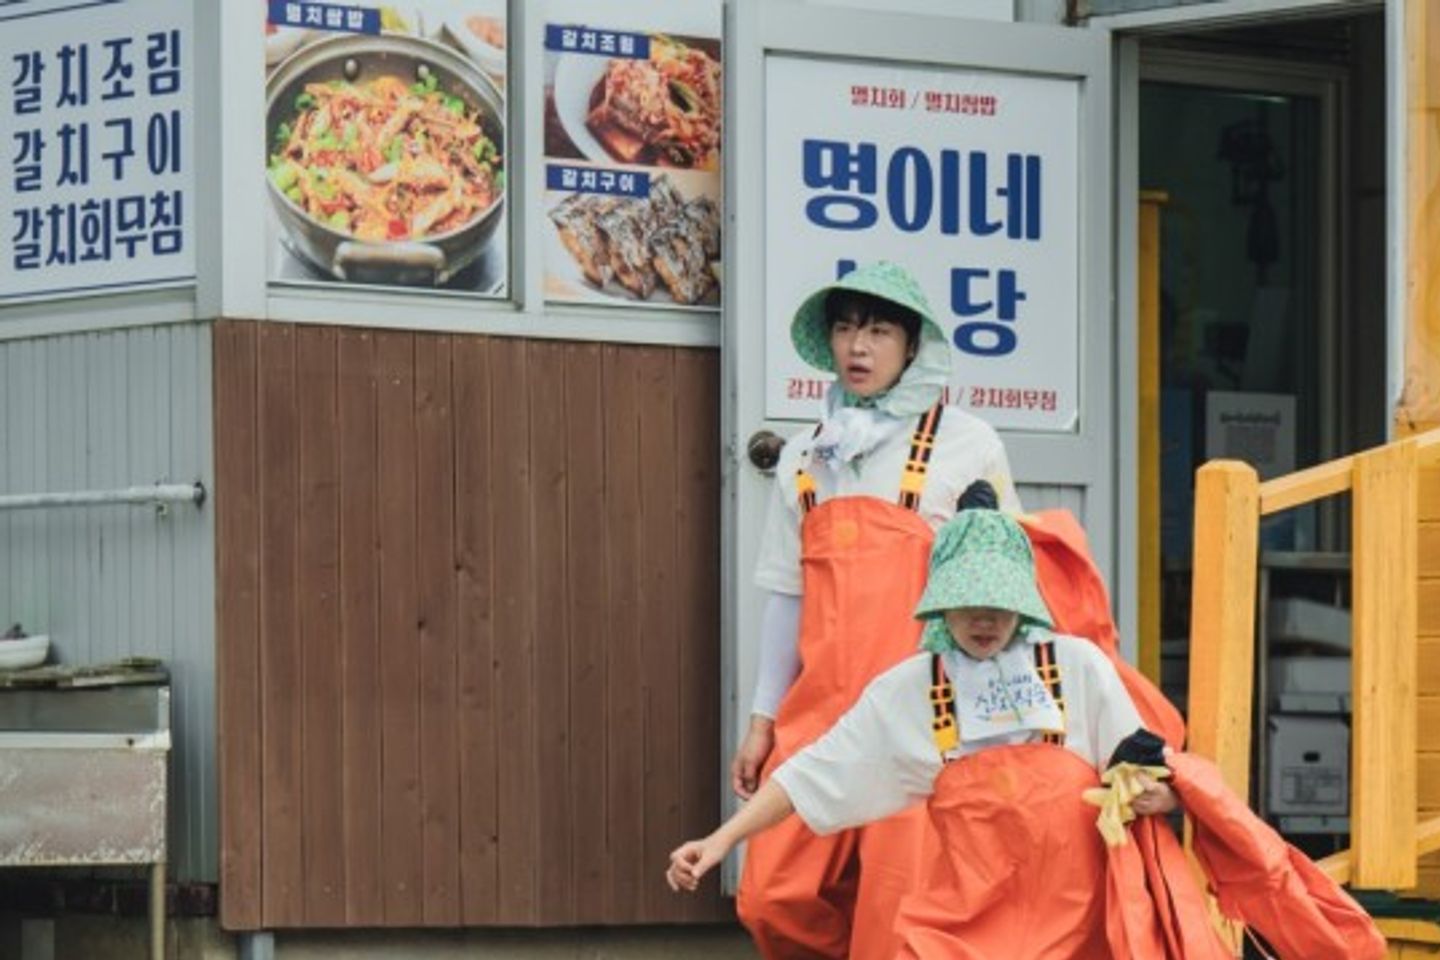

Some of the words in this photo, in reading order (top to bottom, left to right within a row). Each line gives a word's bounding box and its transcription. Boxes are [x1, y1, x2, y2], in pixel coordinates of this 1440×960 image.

[12, 29, 180, 115] 갈치조림
[562, 29, 634, 54] 갈치조림
[851, 86, 905, 109] 멸치회
[12, 110, 181, 192] 갈치구이
[562, 168, 634, 192] 갈치구이
[802, 139, 1041, 241] 명이네
[12, 190, 183, 270] 갈치회무침
